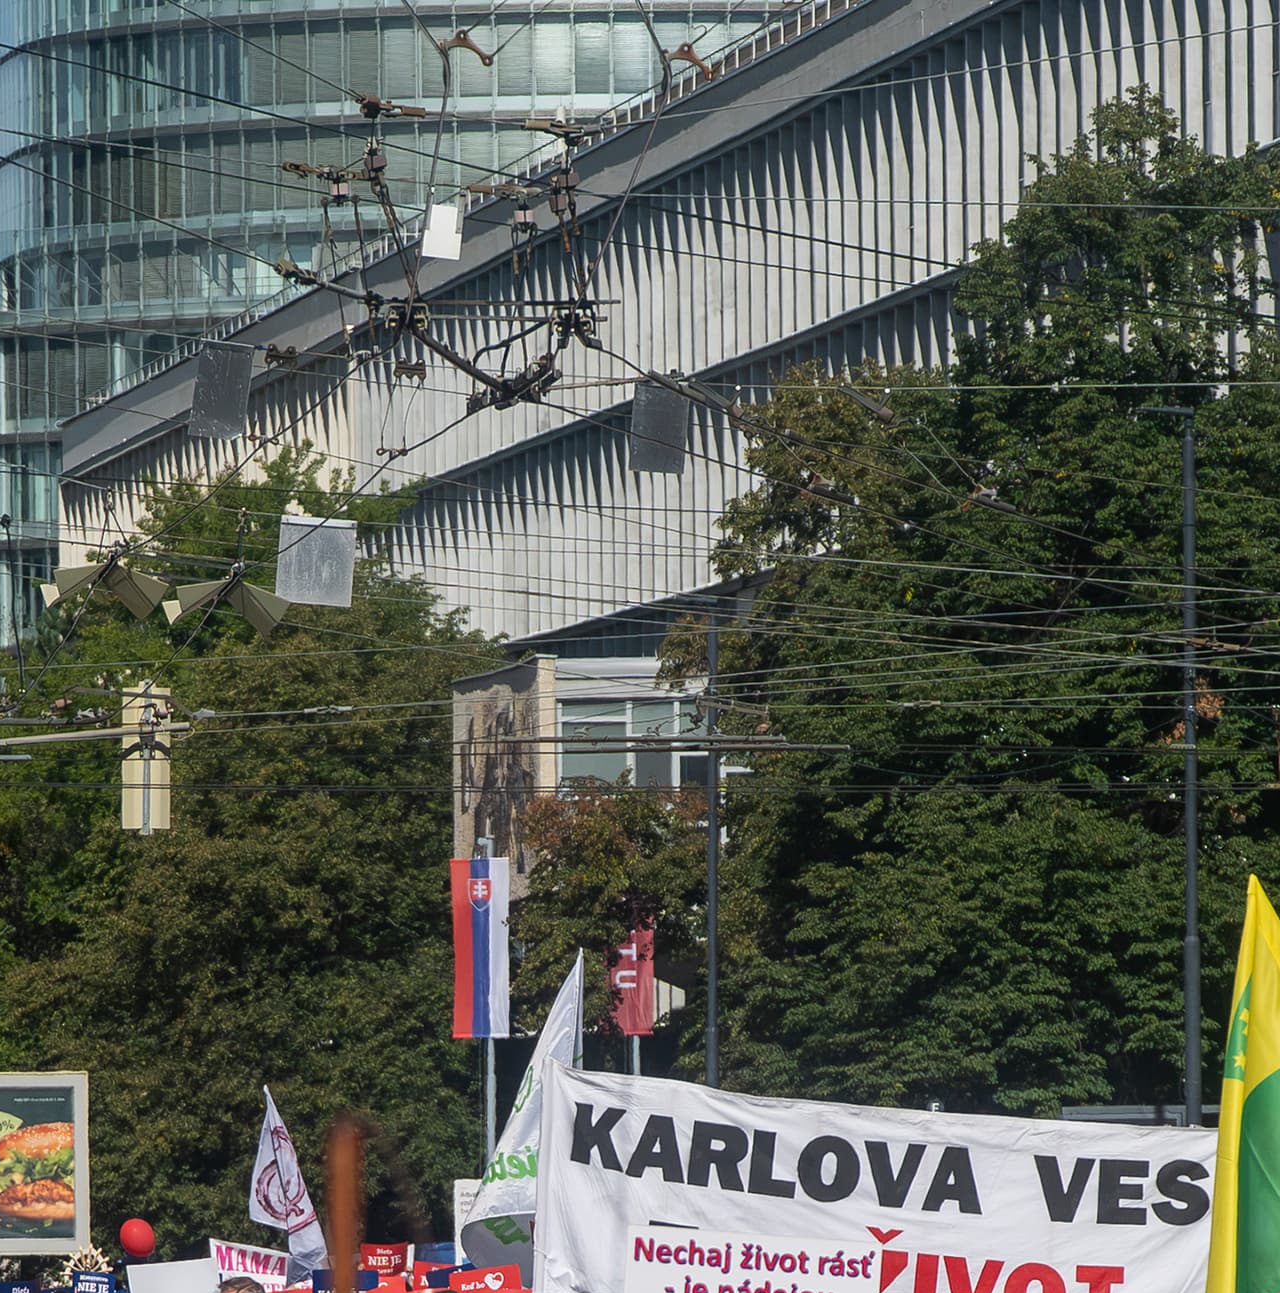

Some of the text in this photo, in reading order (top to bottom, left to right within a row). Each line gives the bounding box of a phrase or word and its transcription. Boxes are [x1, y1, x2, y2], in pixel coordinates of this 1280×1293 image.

[571, 1102, 1210, 1226] KARLOVA VES
[216, 1244, 287, 1276] MAMA
[368, 1255, 402, 1268] NIE JE
[633, 1237, 876, 1279] Nechaj život rásť
[77, 1282, 96, 1293] NIE
